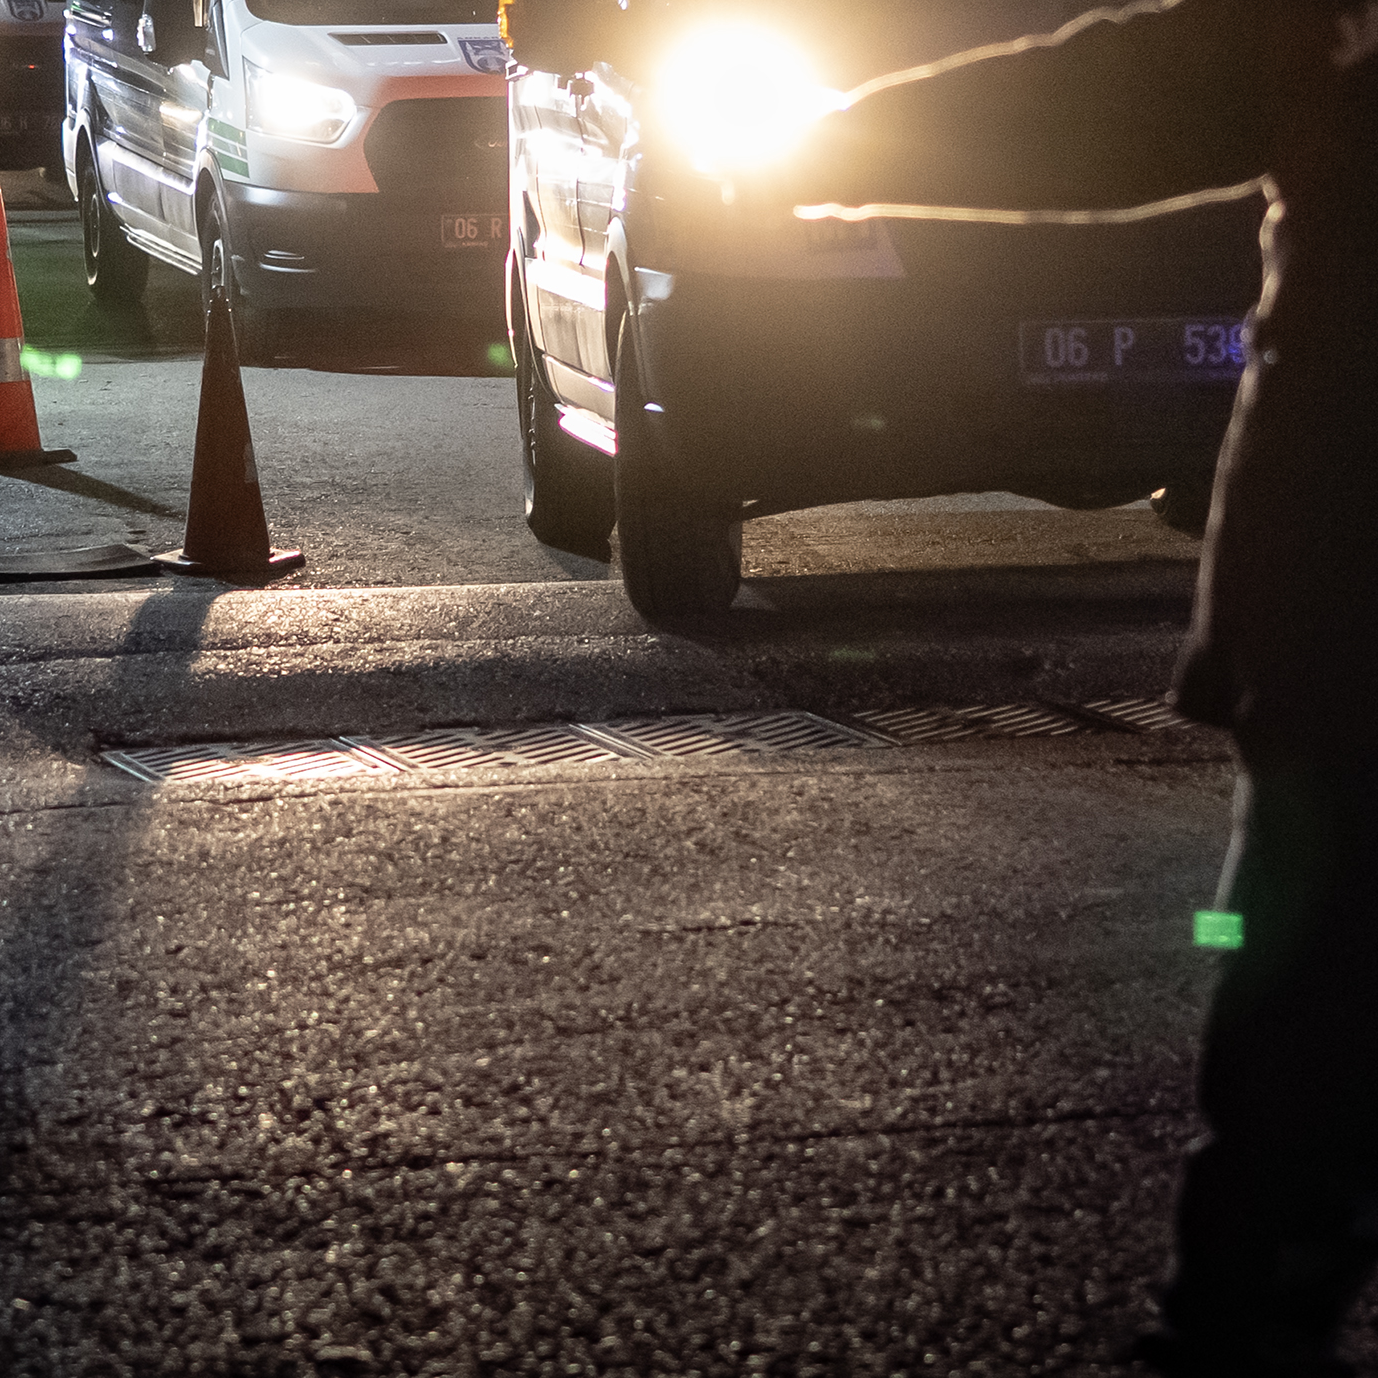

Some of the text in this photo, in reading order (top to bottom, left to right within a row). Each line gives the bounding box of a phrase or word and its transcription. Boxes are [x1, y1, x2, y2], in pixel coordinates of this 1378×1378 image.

[454, 217, 479, 240] 06
[1044, 326, 1090, 368] 06
[1112, 325, 1135, 367] P
